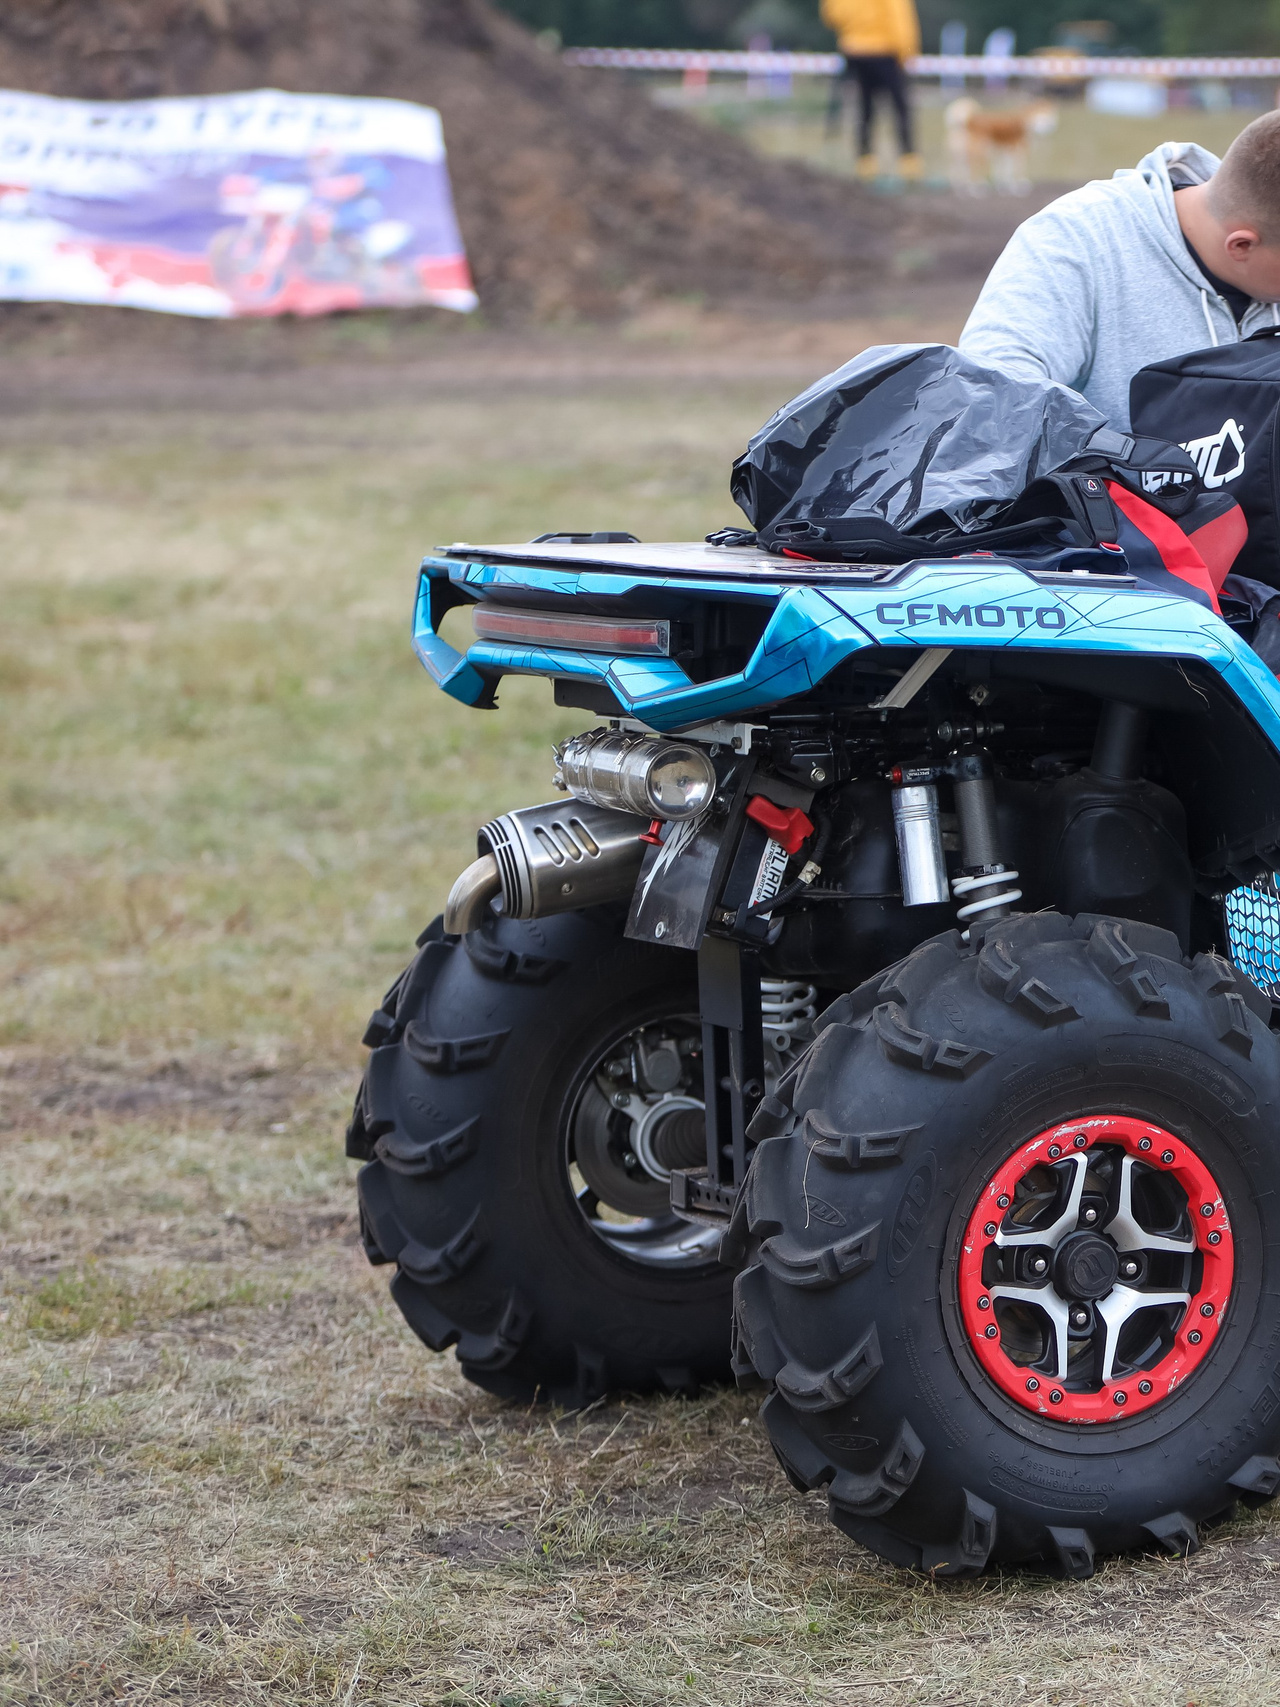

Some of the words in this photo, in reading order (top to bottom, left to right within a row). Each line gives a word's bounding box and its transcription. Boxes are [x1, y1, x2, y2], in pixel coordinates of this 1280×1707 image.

[876, 602, 1066, 630] CFMOTO
[1026, 1459, 1074, 1480] TUBELESS
[1026, 1472, 1069, 1491] HIGHWAY
